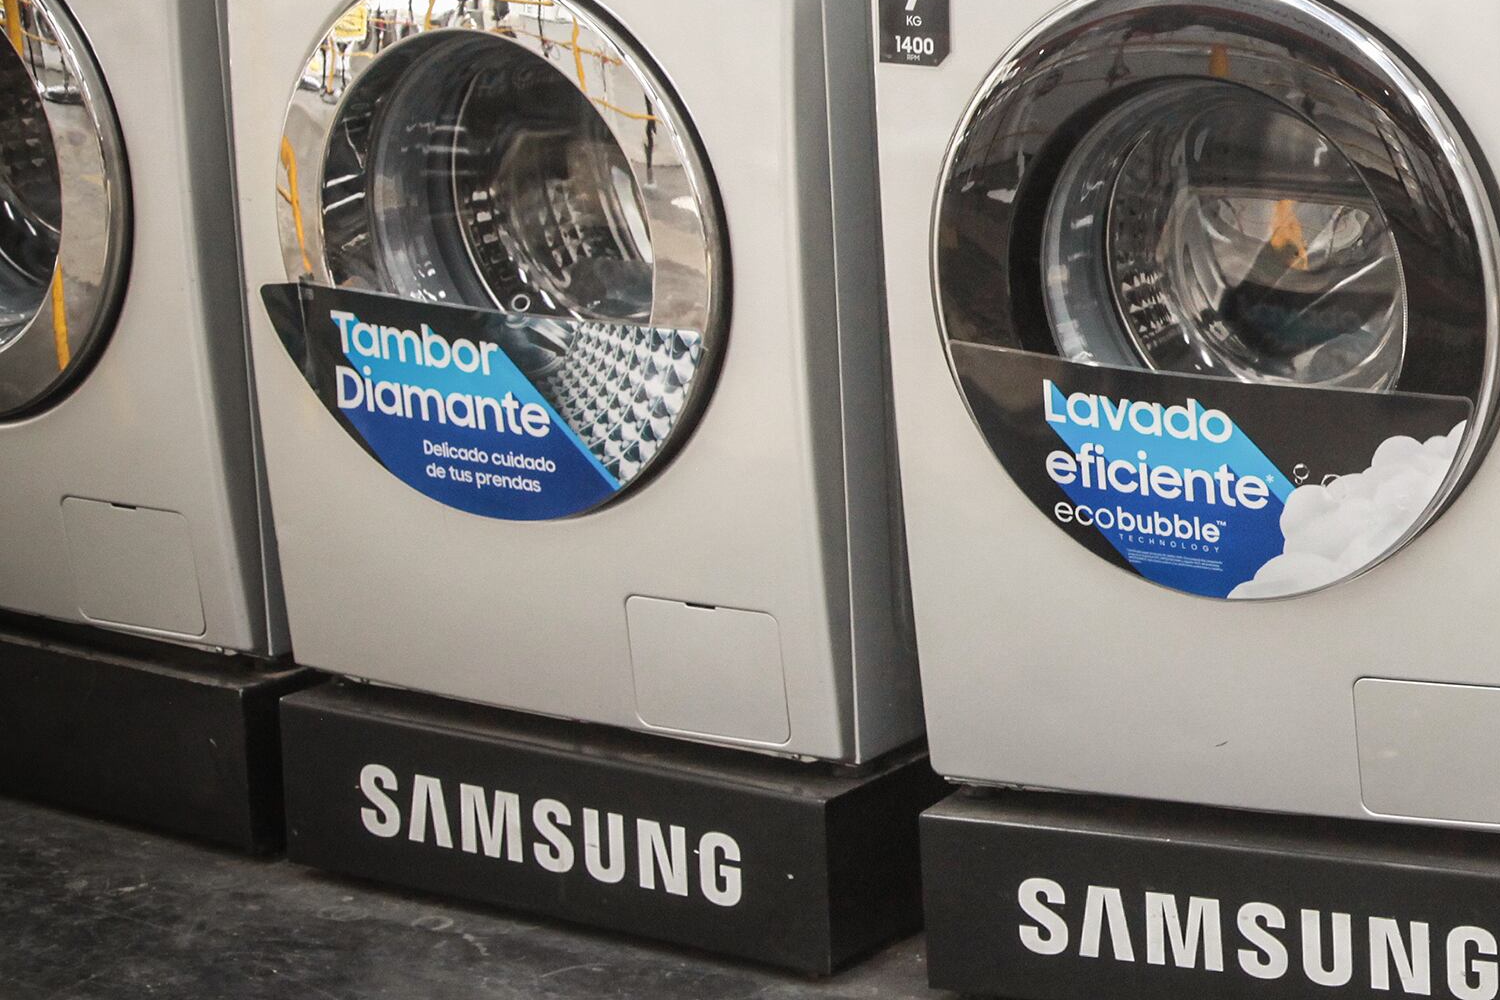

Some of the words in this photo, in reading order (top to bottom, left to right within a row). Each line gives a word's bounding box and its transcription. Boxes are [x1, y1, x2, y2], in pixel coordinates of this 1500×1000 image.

[895, 35, 934, 55] 1400
[905, 15, 922, 27] KG
[330, 310, 500, 377] Tambor
[335, 364, 551, 438] Diamante
[1043, 379, 1233, 444] Lavado
[423, 439, 488, 463] Delicado
[492, 451, 556, 473] cuidado
[426, 462, 446, 478] de
[448, 466, 473, 483] tus
[475, 471, 542, 492] prendas
[1119, 533, 1220, 553] TECHNOLOGY
[360, 764, 742, 907] SAMSUNG
[1017, 877, 1499, 1000] SAMSUNG
